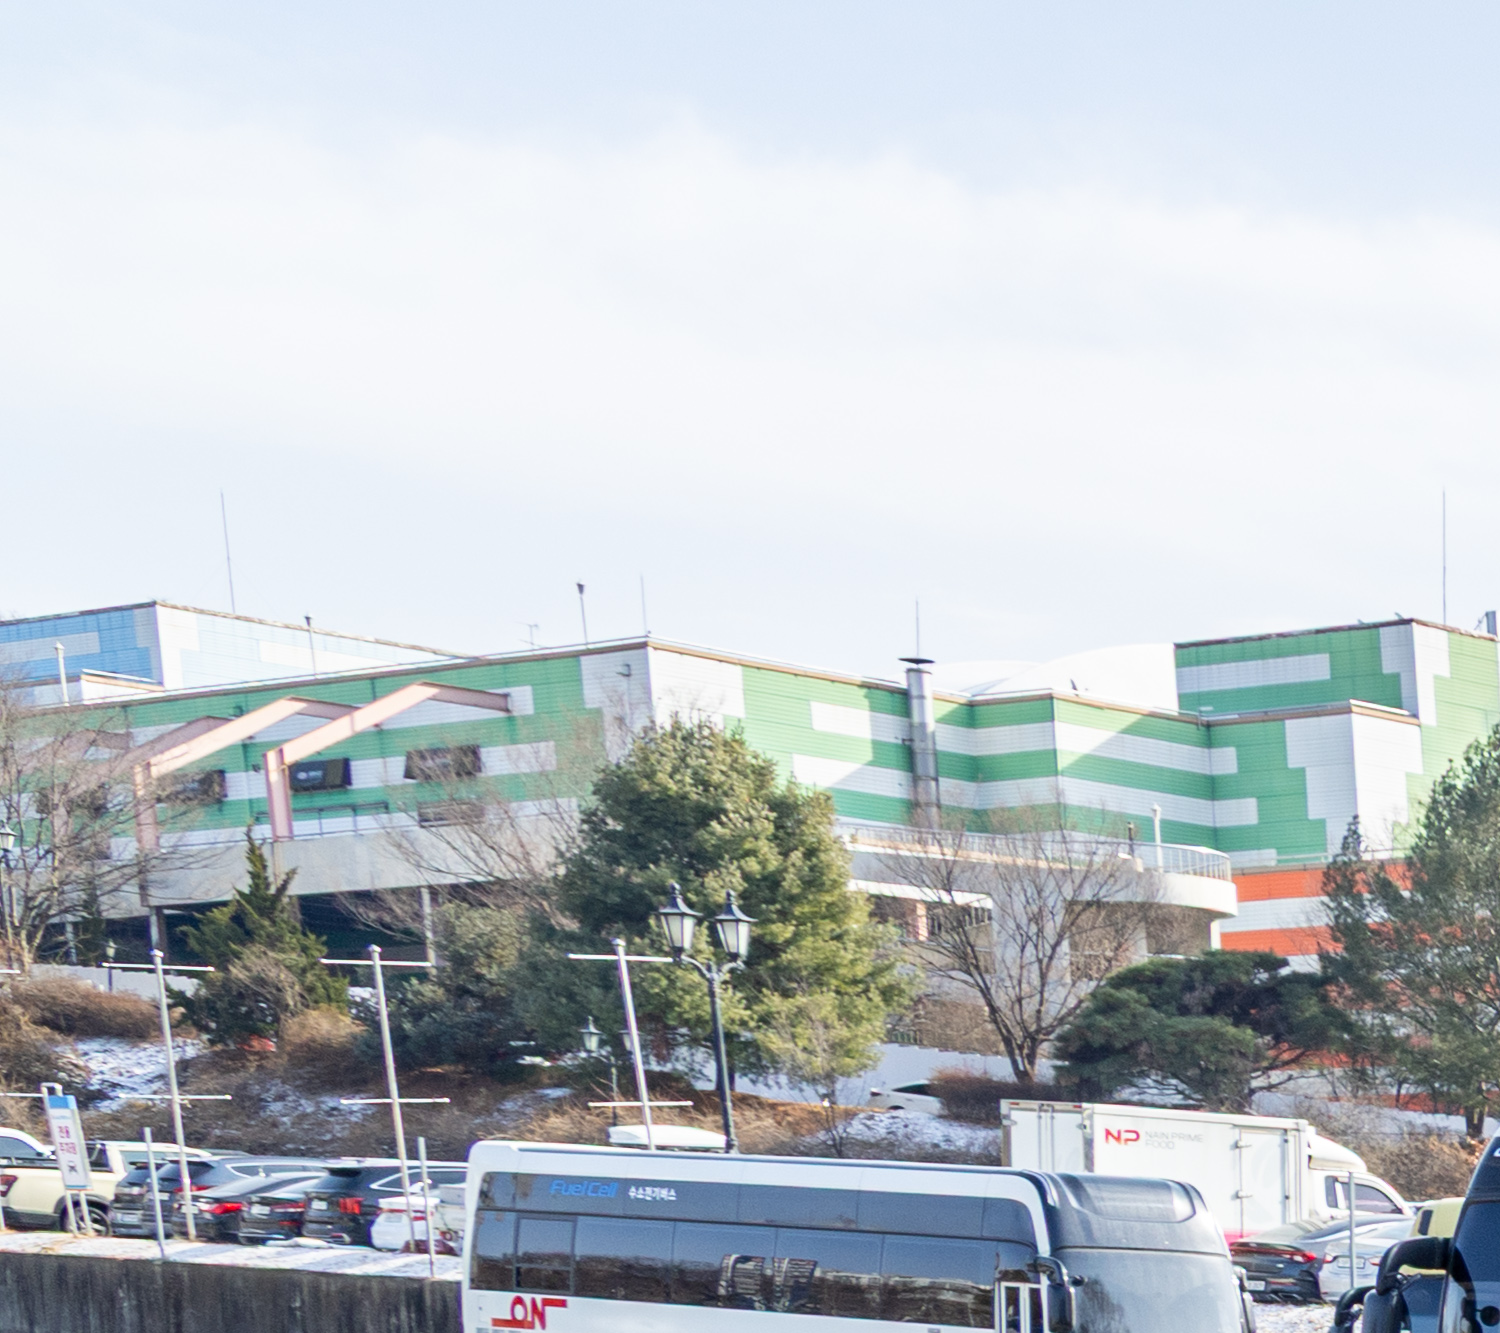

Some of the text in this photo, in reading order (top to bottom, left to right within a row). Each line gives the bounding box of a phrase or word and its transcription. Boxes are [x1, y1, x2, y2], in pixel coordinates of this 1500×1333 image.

[1145, 1140, 1175, 1150] FOOD
[550, 1180, 677, 1201] Fuel Cell 수소전기버스
